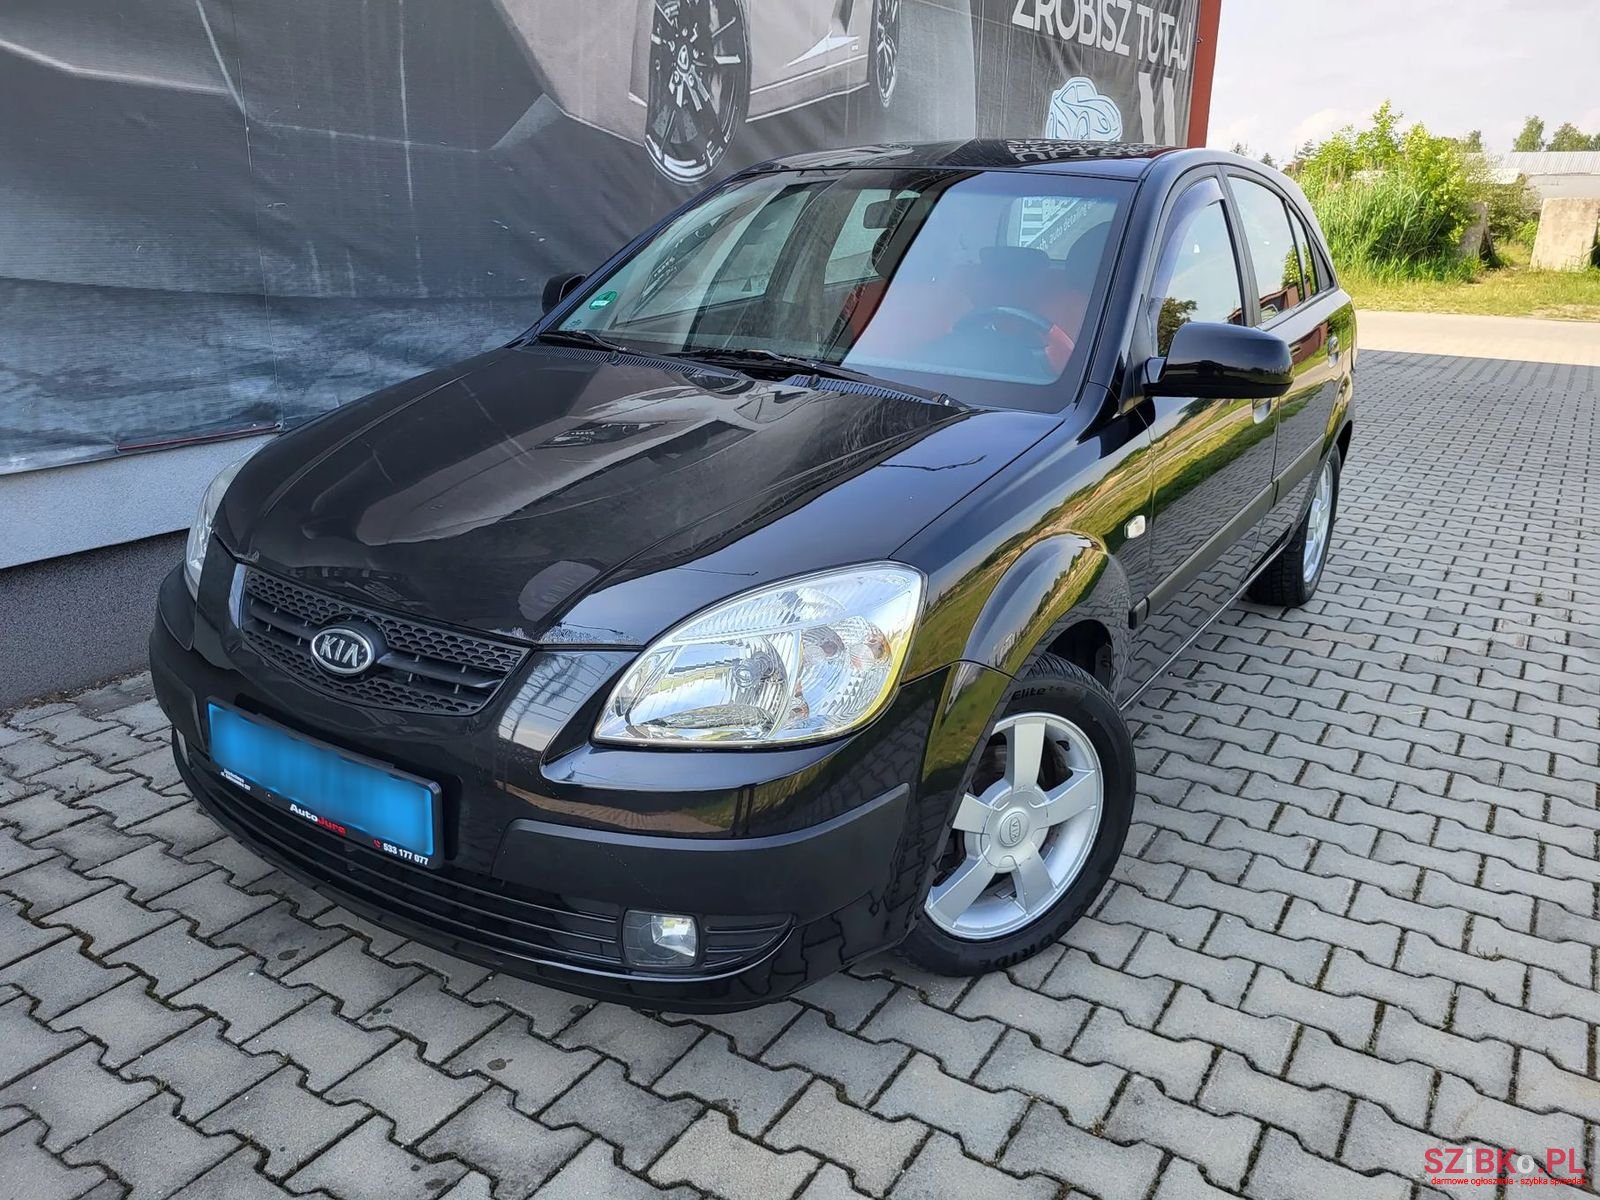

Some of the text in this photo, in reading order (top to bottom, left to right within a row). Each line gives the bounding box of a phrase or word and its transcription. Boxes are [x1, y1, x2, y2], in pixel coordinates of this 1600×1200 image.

[1136, 5, 1192, 71] TUTAJ
[320, 635, 359, 667] KIA
[383, 842, 398, 855] 533
[398, 848, 413, 860] 177
